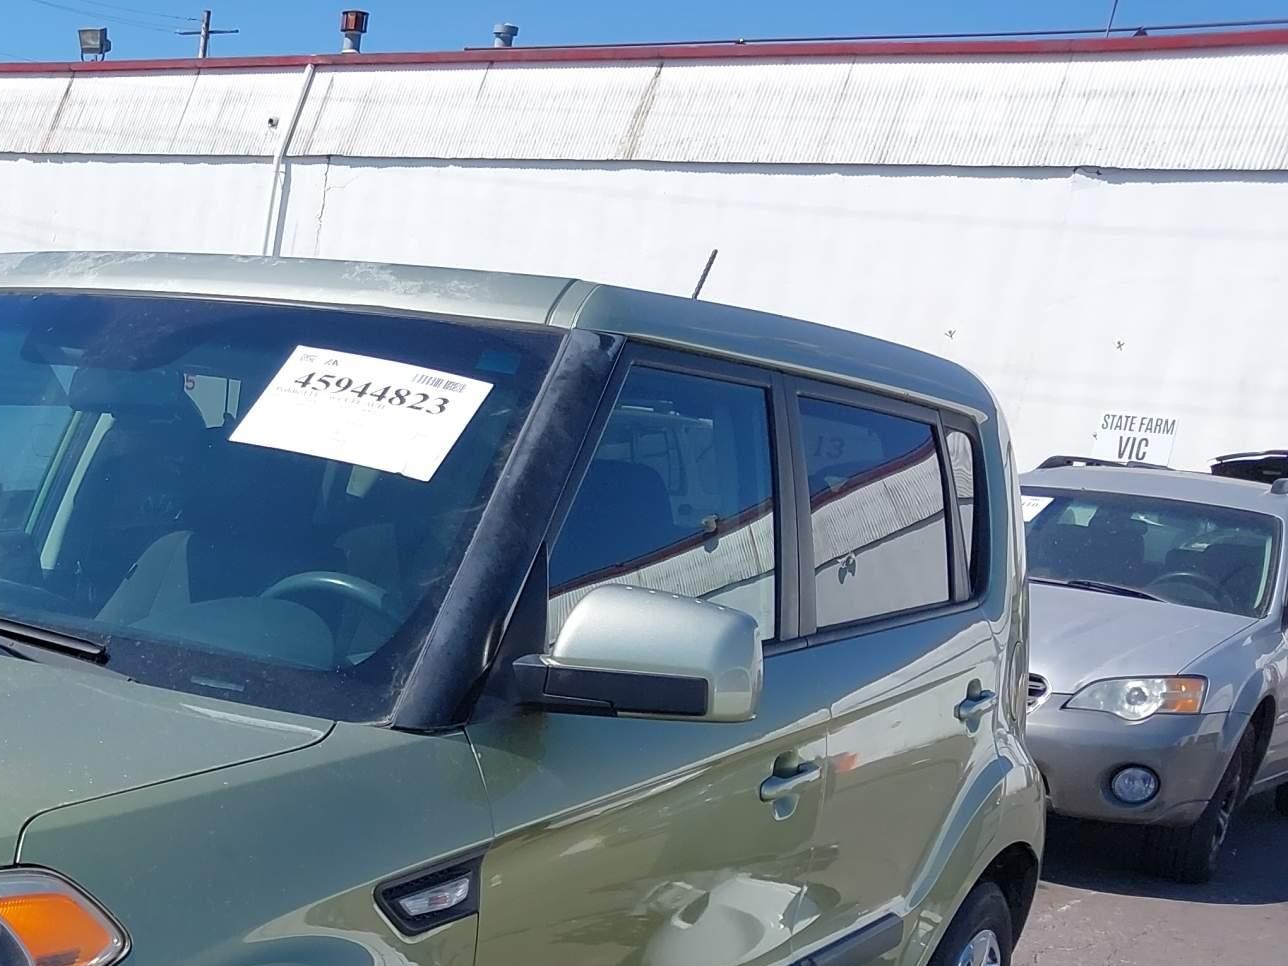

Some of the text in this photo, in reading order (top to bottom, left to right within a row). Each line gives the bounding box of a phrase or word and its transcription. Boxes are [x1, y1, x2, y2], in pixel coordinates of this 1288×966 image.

[294, 372, 450, 415] 45944823
[1101, 413, 1176, 436] STATE FARM
[1117, 435, 1149, 461] VIC
